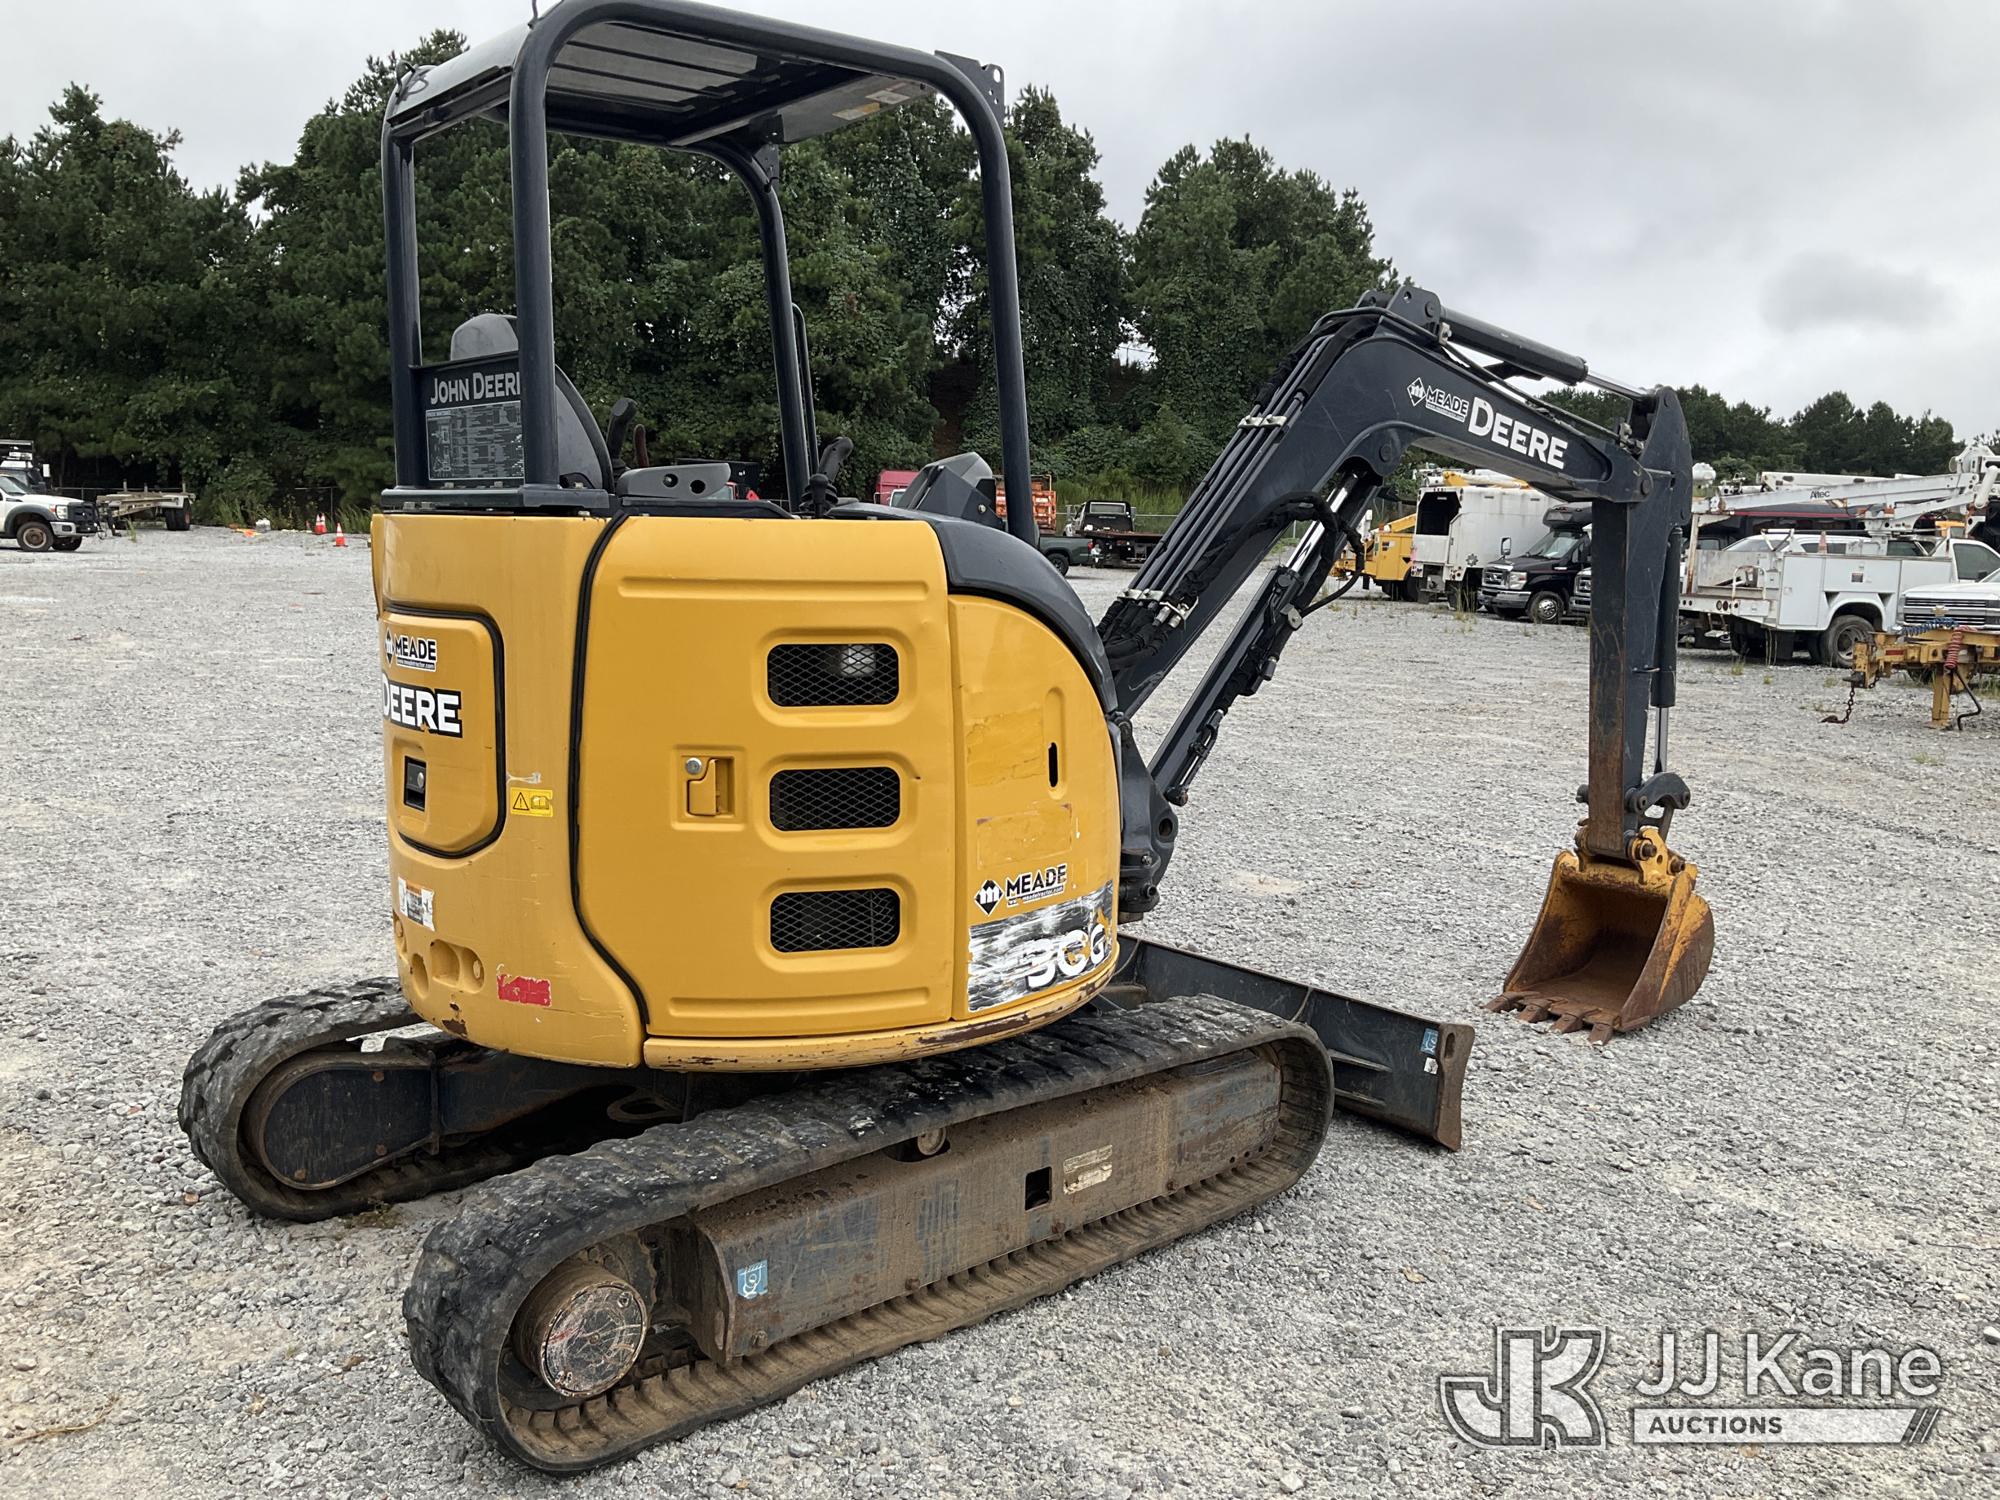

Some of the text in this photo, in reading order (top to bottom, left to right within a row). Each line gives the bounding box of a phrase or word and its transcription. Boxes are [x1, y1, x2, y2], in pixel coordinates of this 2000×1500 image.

[430, 378, 470, 405] JOHN
[1427, 388, 1468, 416] MEADE
[1468, 396, 1569, 470] DEERE
[395, 636, 437, 661] MEADE
[382, 673, 461, 734] DEERE
[1006, 865, 1067, 898] MEADE
